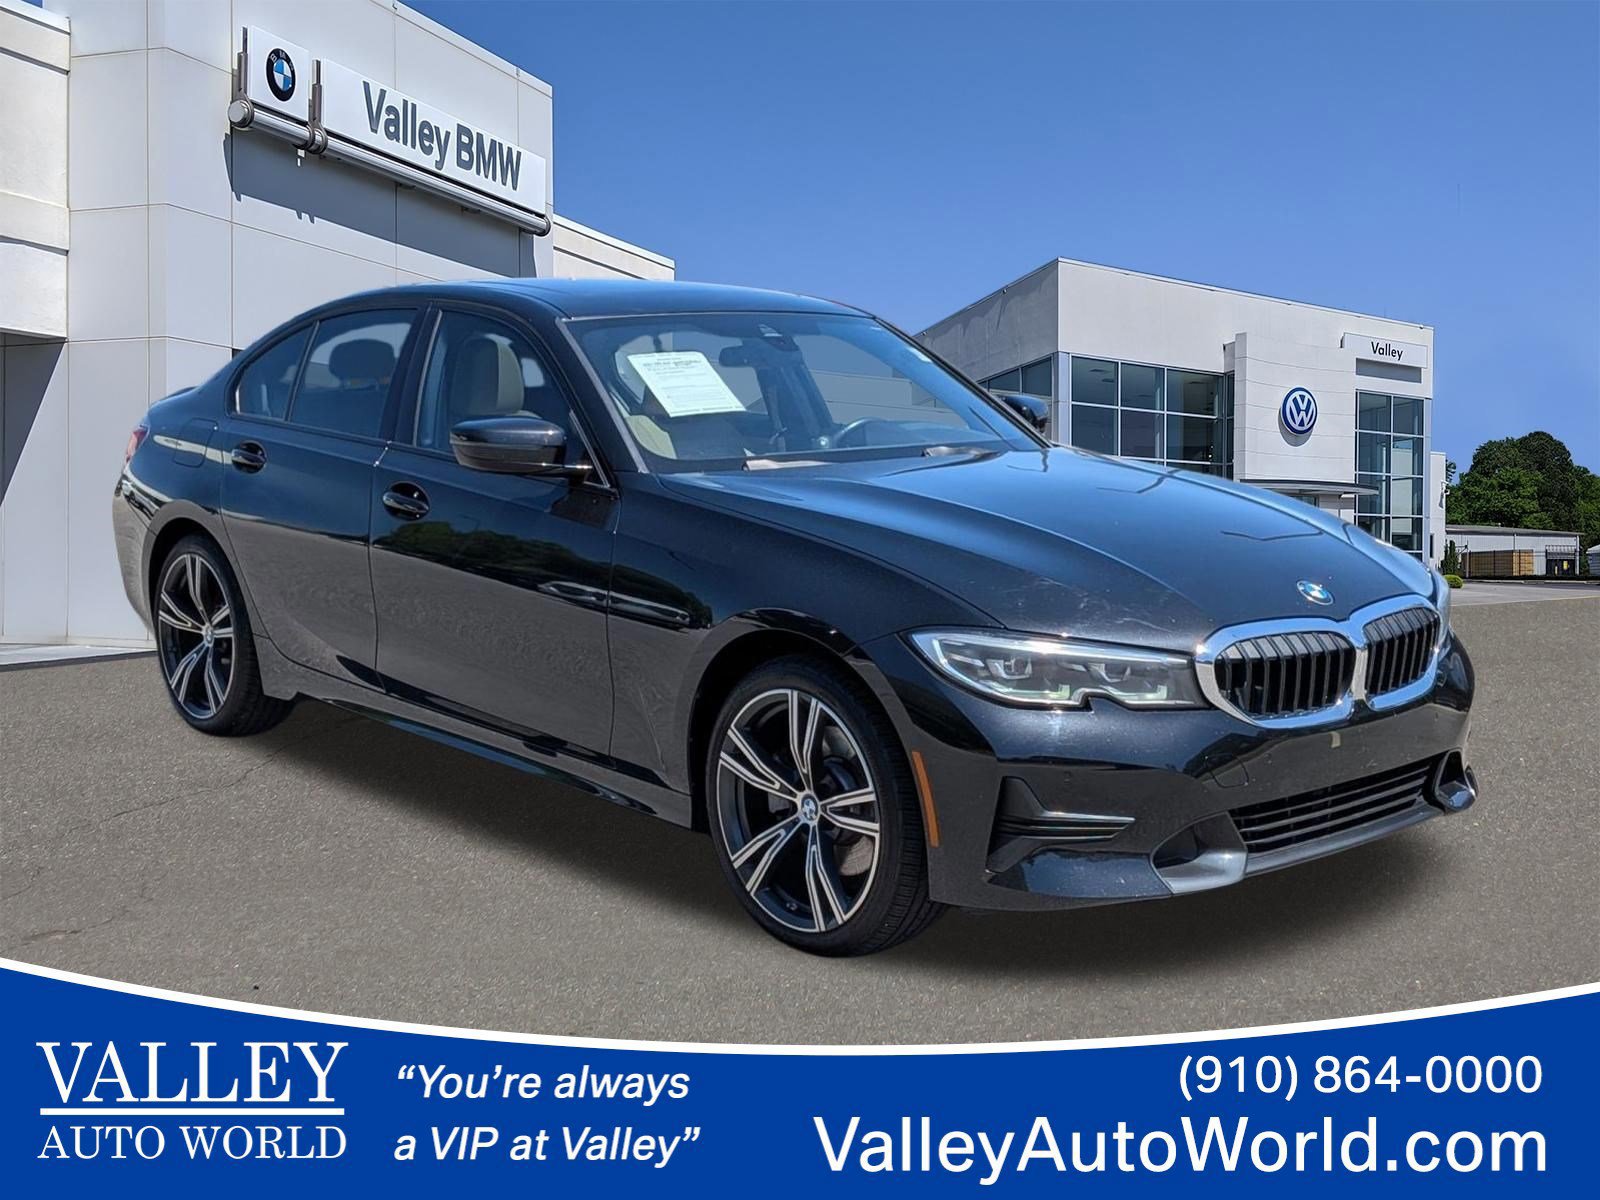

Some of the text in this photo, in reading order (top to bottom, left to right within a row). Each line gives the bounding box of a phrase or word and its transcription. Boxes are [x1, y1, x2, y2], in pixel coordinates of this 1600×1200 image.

[363, 80, 522, 191] Valley BMW
[1371, 341, 1403, 361] Valley
